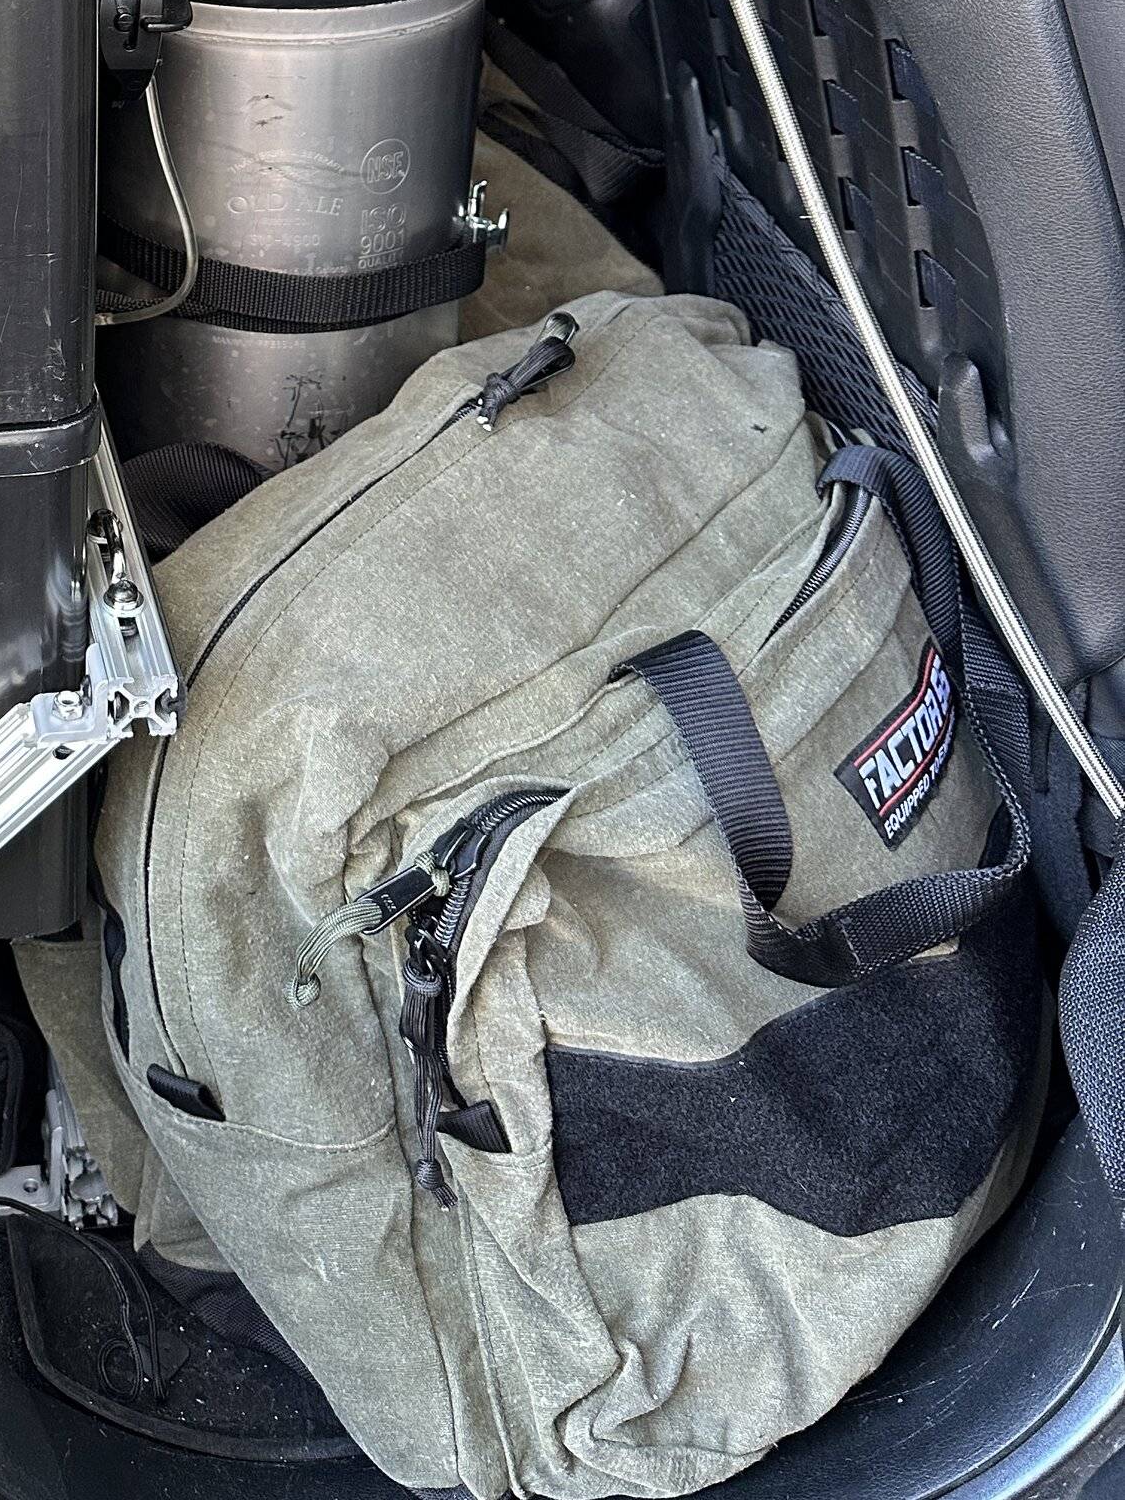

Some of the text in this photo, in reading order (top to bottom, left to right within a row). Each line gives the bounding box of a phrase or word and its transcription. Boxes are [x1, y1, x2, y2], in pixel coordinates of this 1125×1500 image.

[360, 202, 407, 235] ISO
[360, 228, 405, 256] 9001
[883, 773, 930, 840] EQUIPPED
